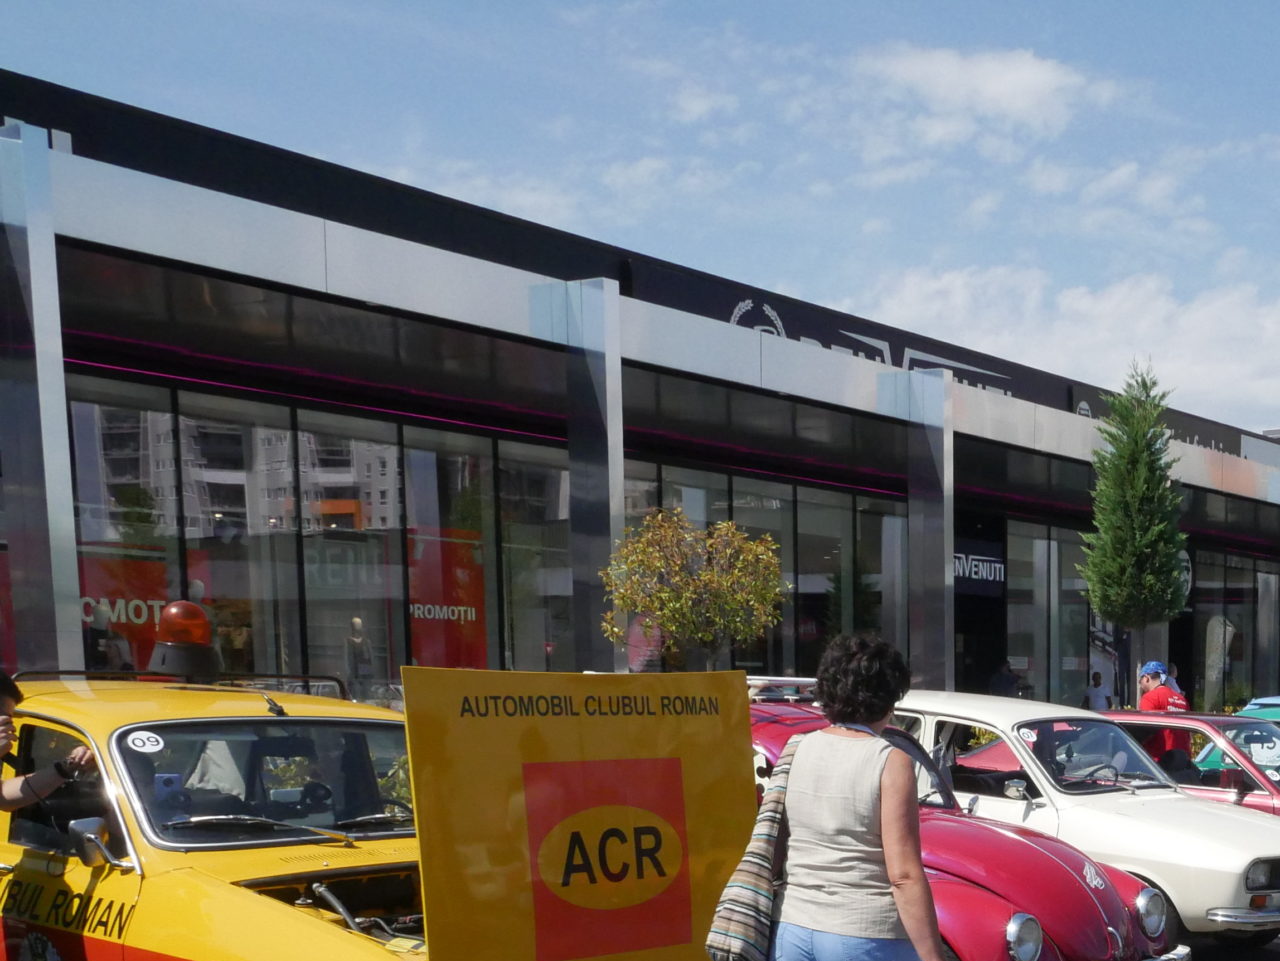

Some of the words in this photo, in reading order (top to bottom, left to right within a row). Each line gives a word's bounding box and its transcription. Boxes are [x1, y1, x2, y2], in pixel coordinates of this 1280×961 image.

[953, 554, 1005, 582] NVENUTI
[460, 695, 580, 717] AUTOMOBIL
[584, 695, 656, 716] CLUBUL
[661, 695, 719, 716] ROMAN
[131, 736, 160, 748] 09
[561, 826, 667, 887] ACR
[46, 889, 136, 940] ROMAN
